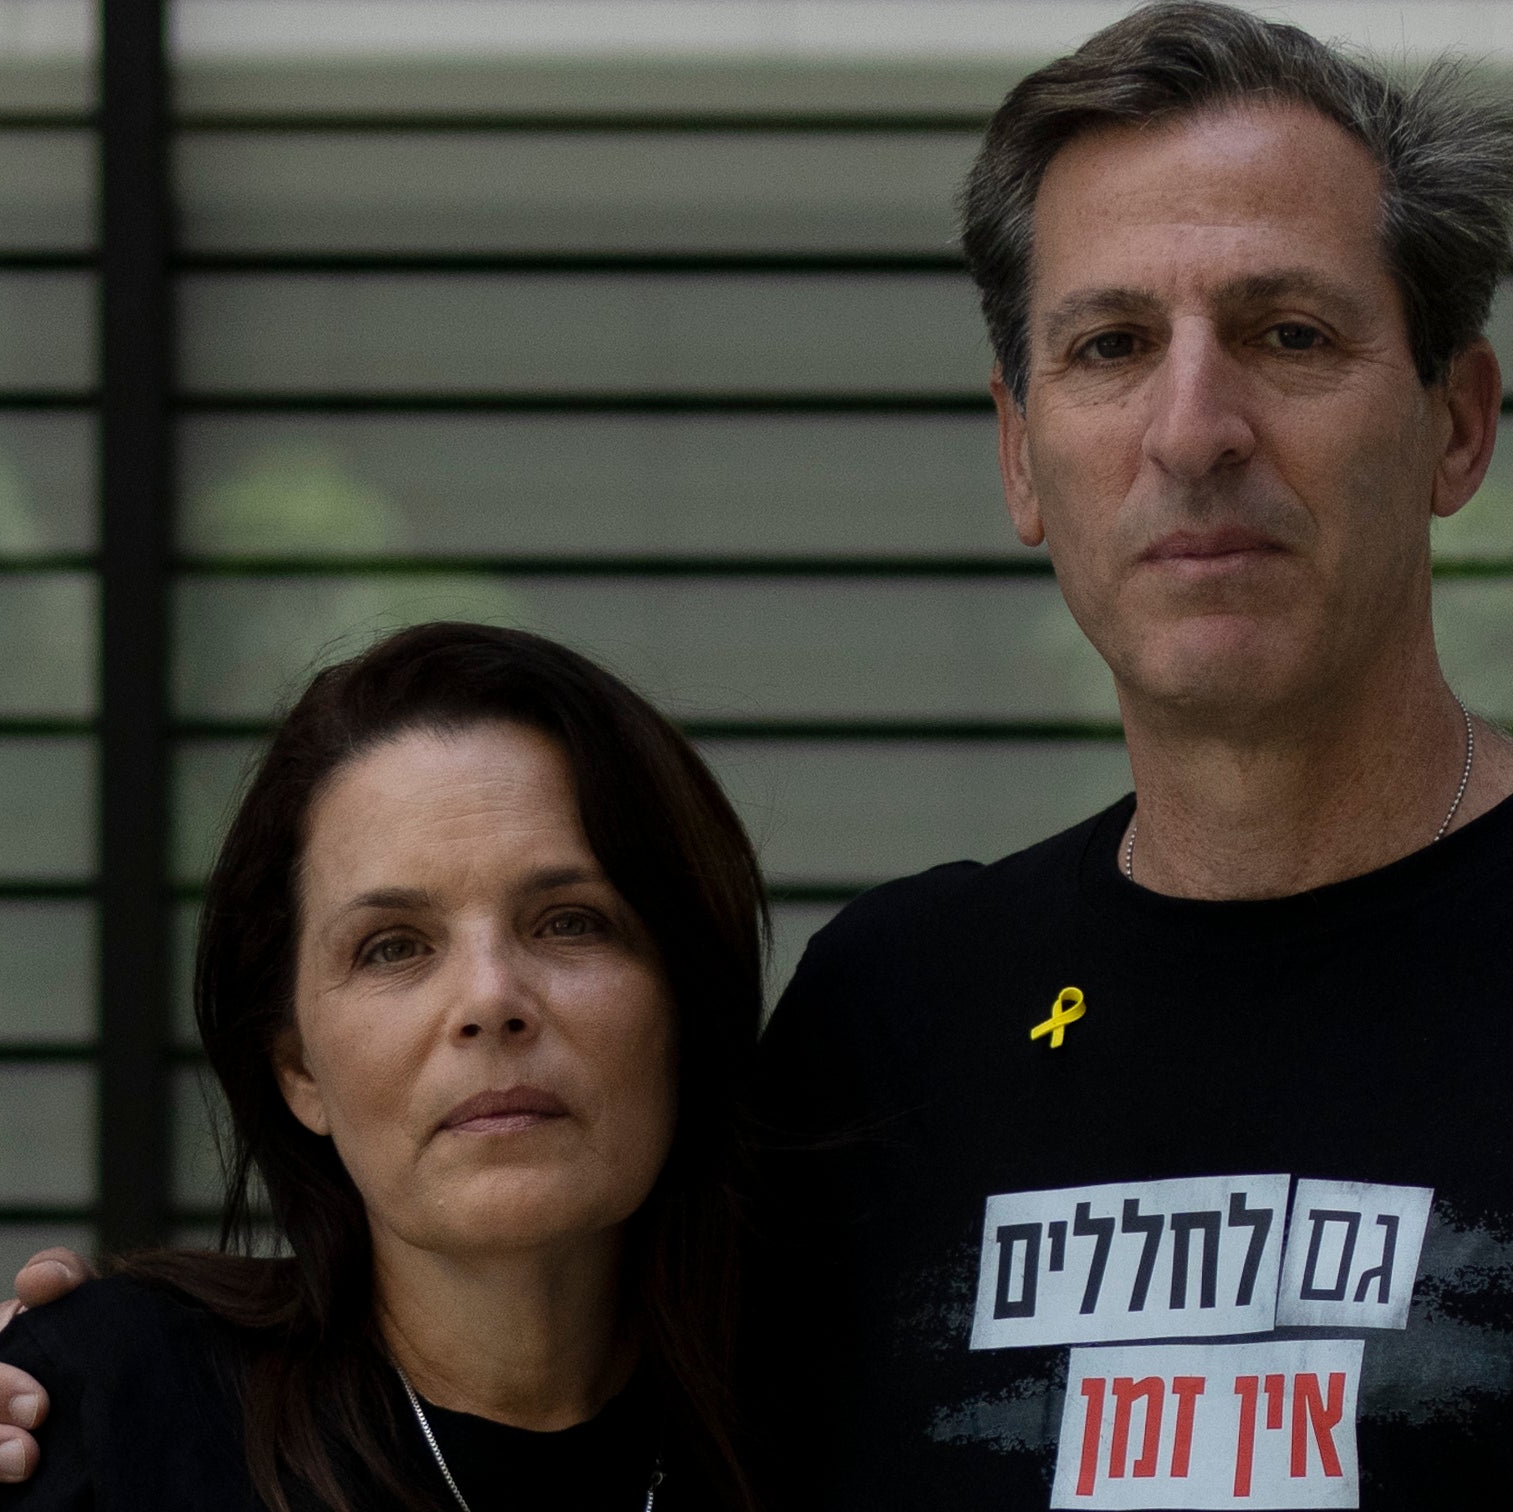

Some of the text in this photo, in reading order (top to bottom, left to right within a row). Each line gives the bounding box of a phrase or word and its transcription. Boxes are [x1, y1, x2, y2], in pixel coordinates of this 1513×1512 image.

[994, 1192, 1399, 1319] גם לחללים
[1076, 1371, 1347, 1498] אין זמן
